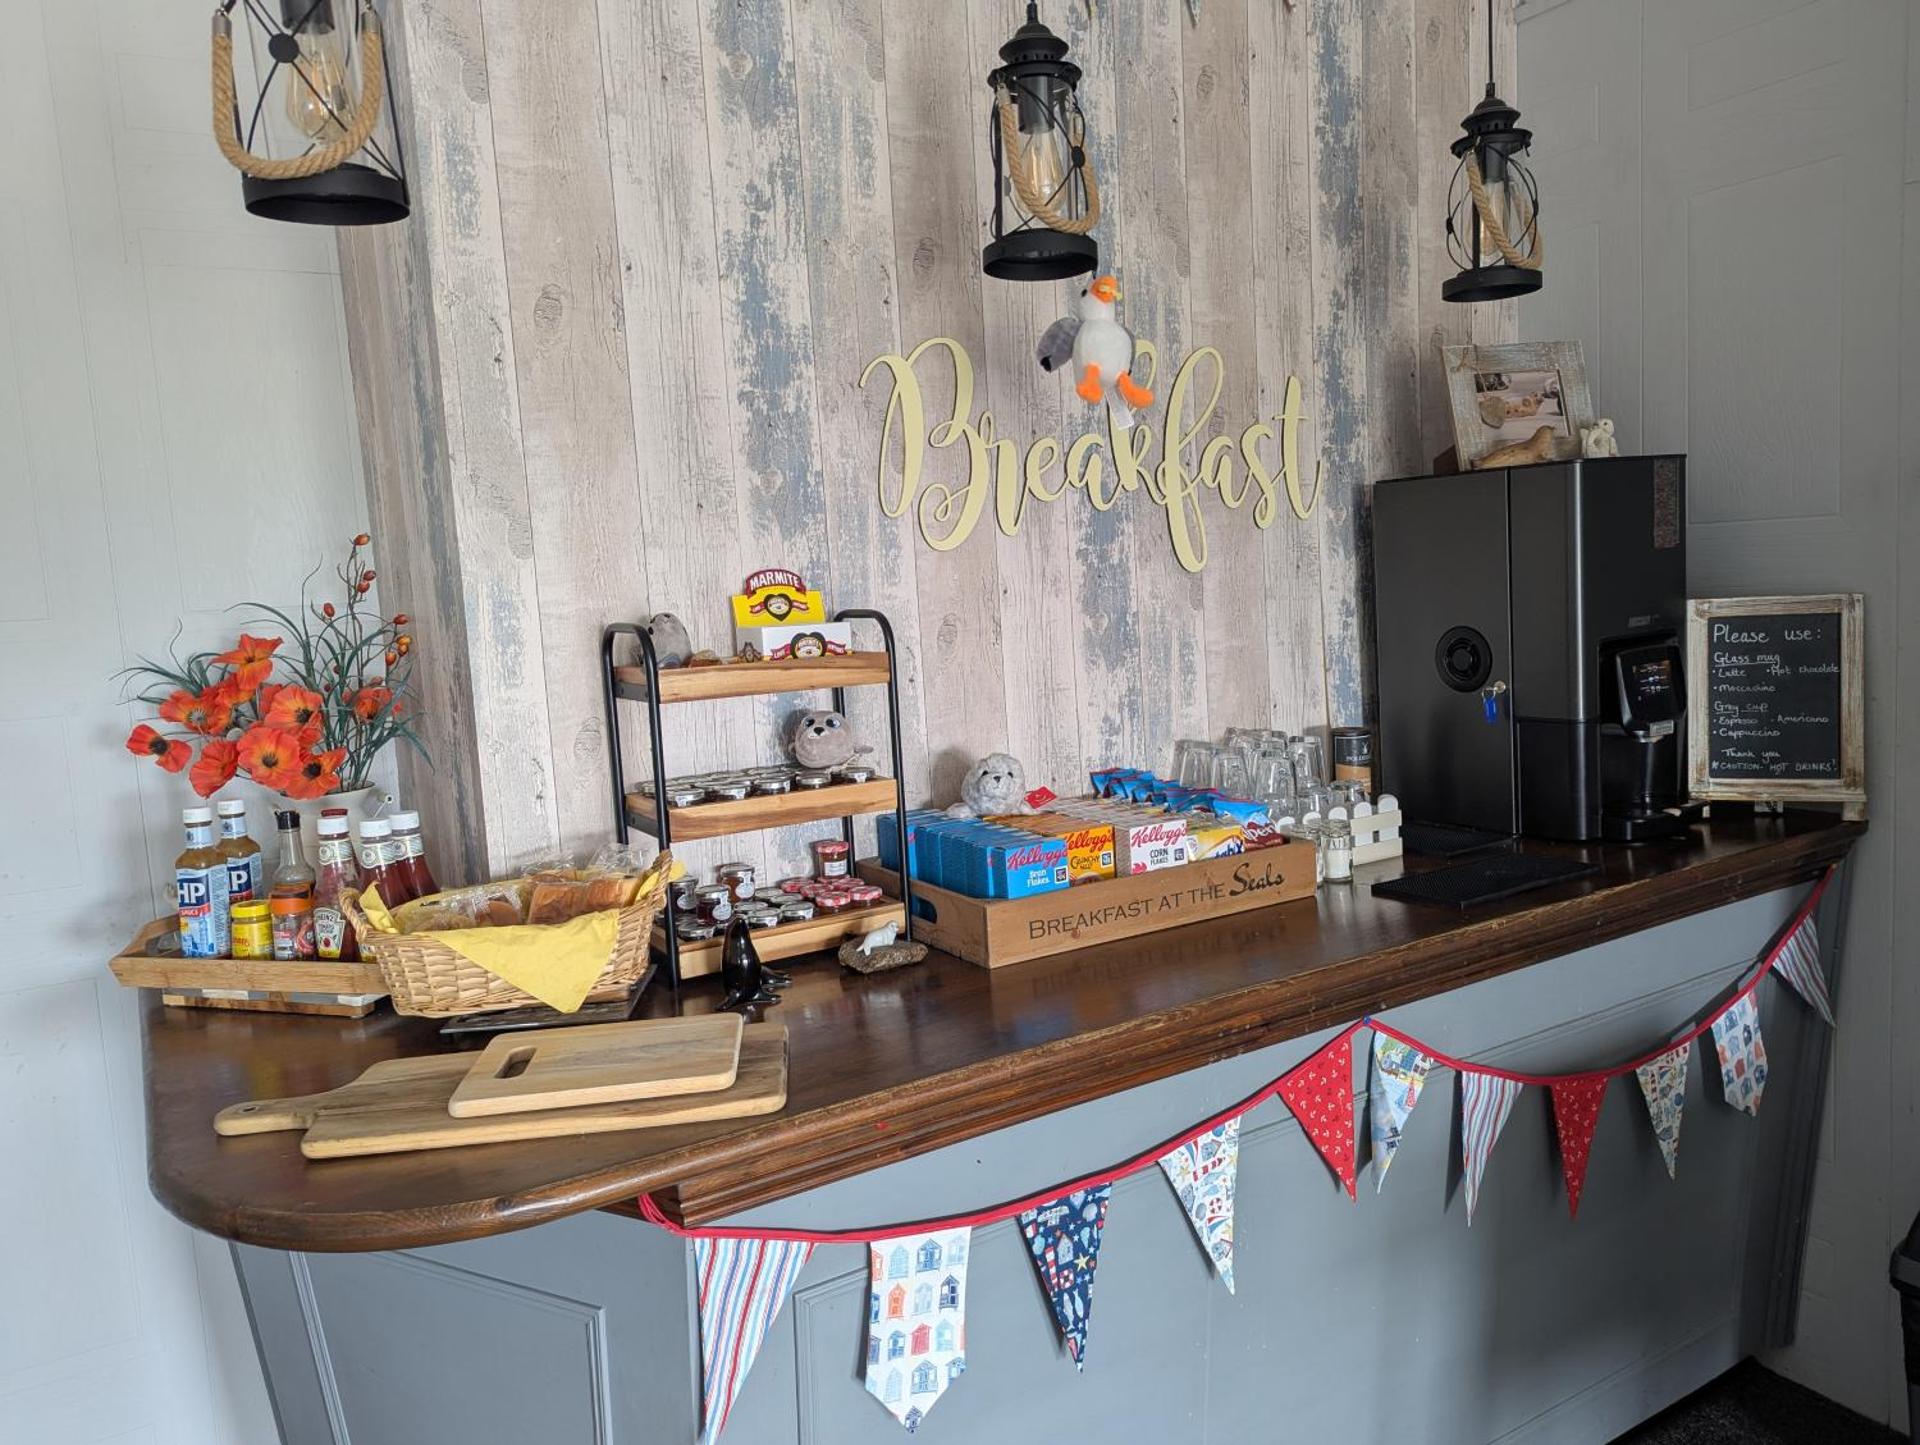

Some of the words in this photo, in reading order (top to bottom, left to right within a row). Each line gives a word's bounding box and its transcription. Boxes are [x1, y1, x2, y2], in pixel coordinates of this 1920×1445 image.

[859, 337, 1323, 572] Breakfast
[750, 571, 800, 591] MARMITE
[1713, 624, 1769, 643] Please
[1714, 652, 1749, 663] Glass
[1757, 654, 1780, 668] mug
[1718, 668, 1747, 678] Latte
[1720, 748, 1756, 758] Thank
[1761, 751, 1781, 764] you
[1131, 823, 1187, 848] Kellogg's
[1007, 844, 1068, 871] Kellogg's
[1150, 848, 1168, 859] CORN
[178, 882, 206, 905] HP
[1028, 898, 1155, 940] BREAKFAST
[1158, 892, 1184, 912] AT
[1188, 883, 1226, 902] THE
[1229, 862, 1286, 897] Seals
